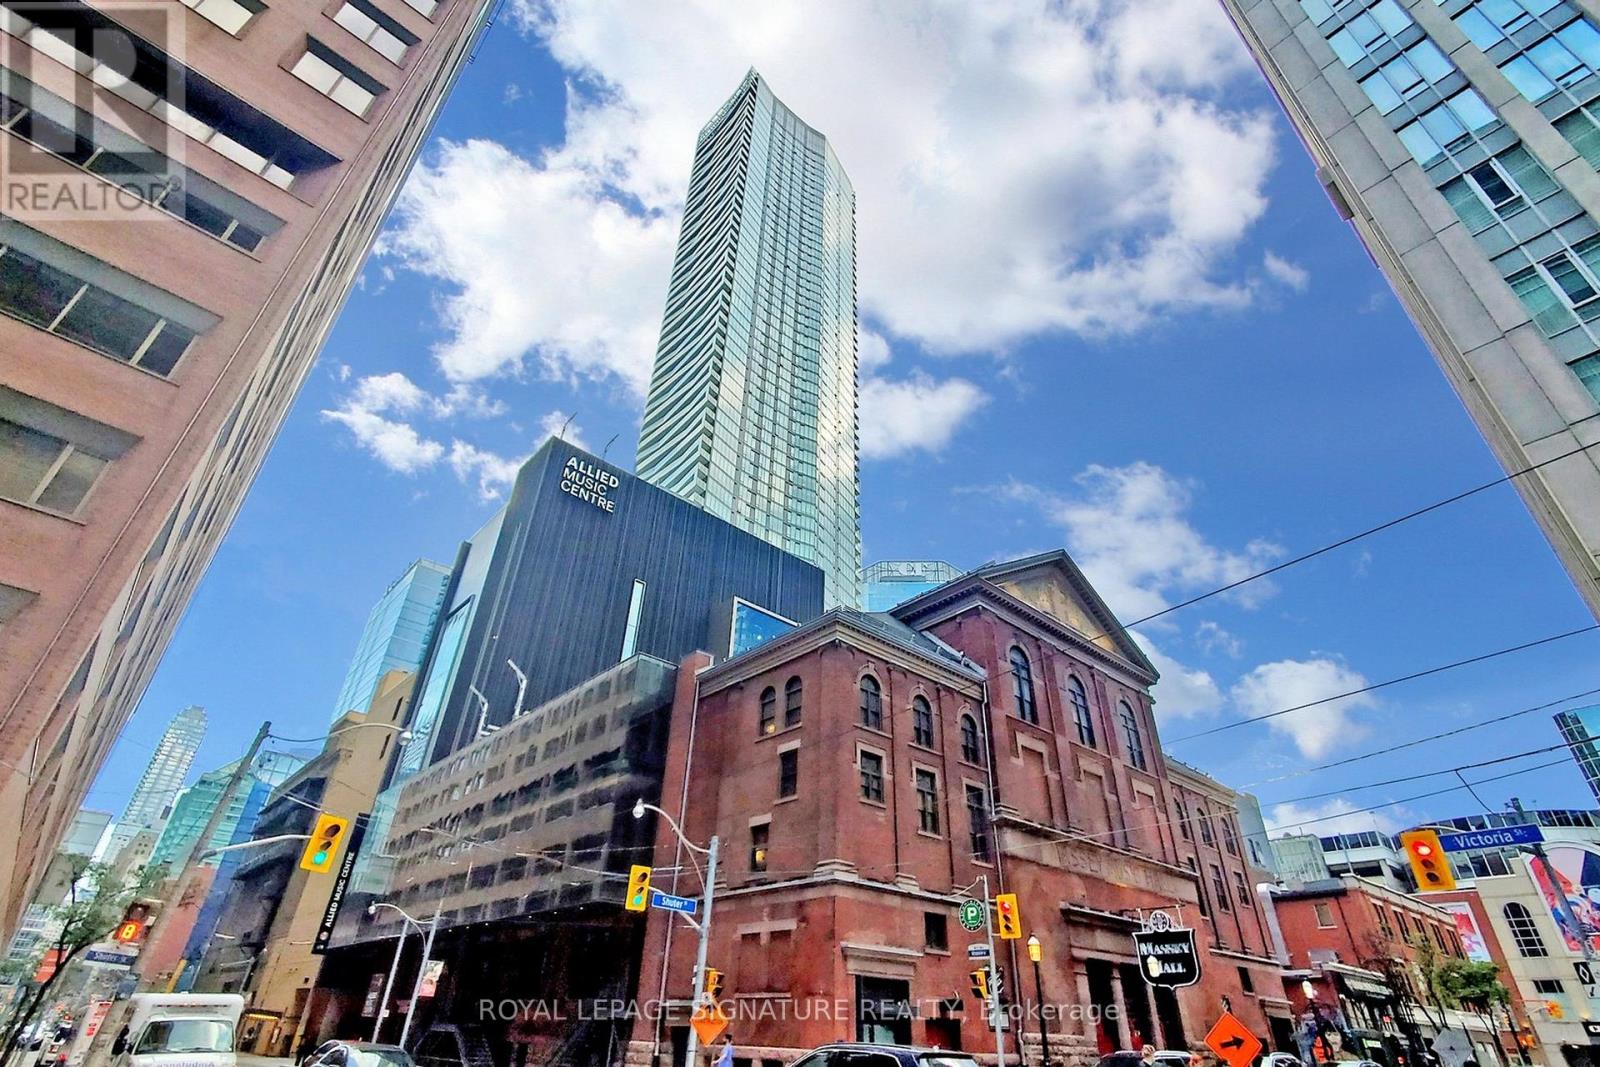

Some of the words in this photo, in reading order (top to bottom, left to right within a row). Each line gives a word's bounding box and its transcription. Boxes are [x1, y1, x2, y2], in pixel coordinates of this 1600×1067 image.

[563, 467, 607, 496] MUSIC
[566, 456, 619, 488] ALLIED
[560, 480, 615, 513] CENTRE
[1454, 831, 1514, 849] Victoria
[324, 902, 339, 928] ALLIED
[333, 880, 346, 902] MUSIC
[341, 851, 355, 878] CENTRE
[661, 896, 684, 909] Shuter
[966, 906, 978, 921] P
[1139, 942, 1190, 956] MASSEY
